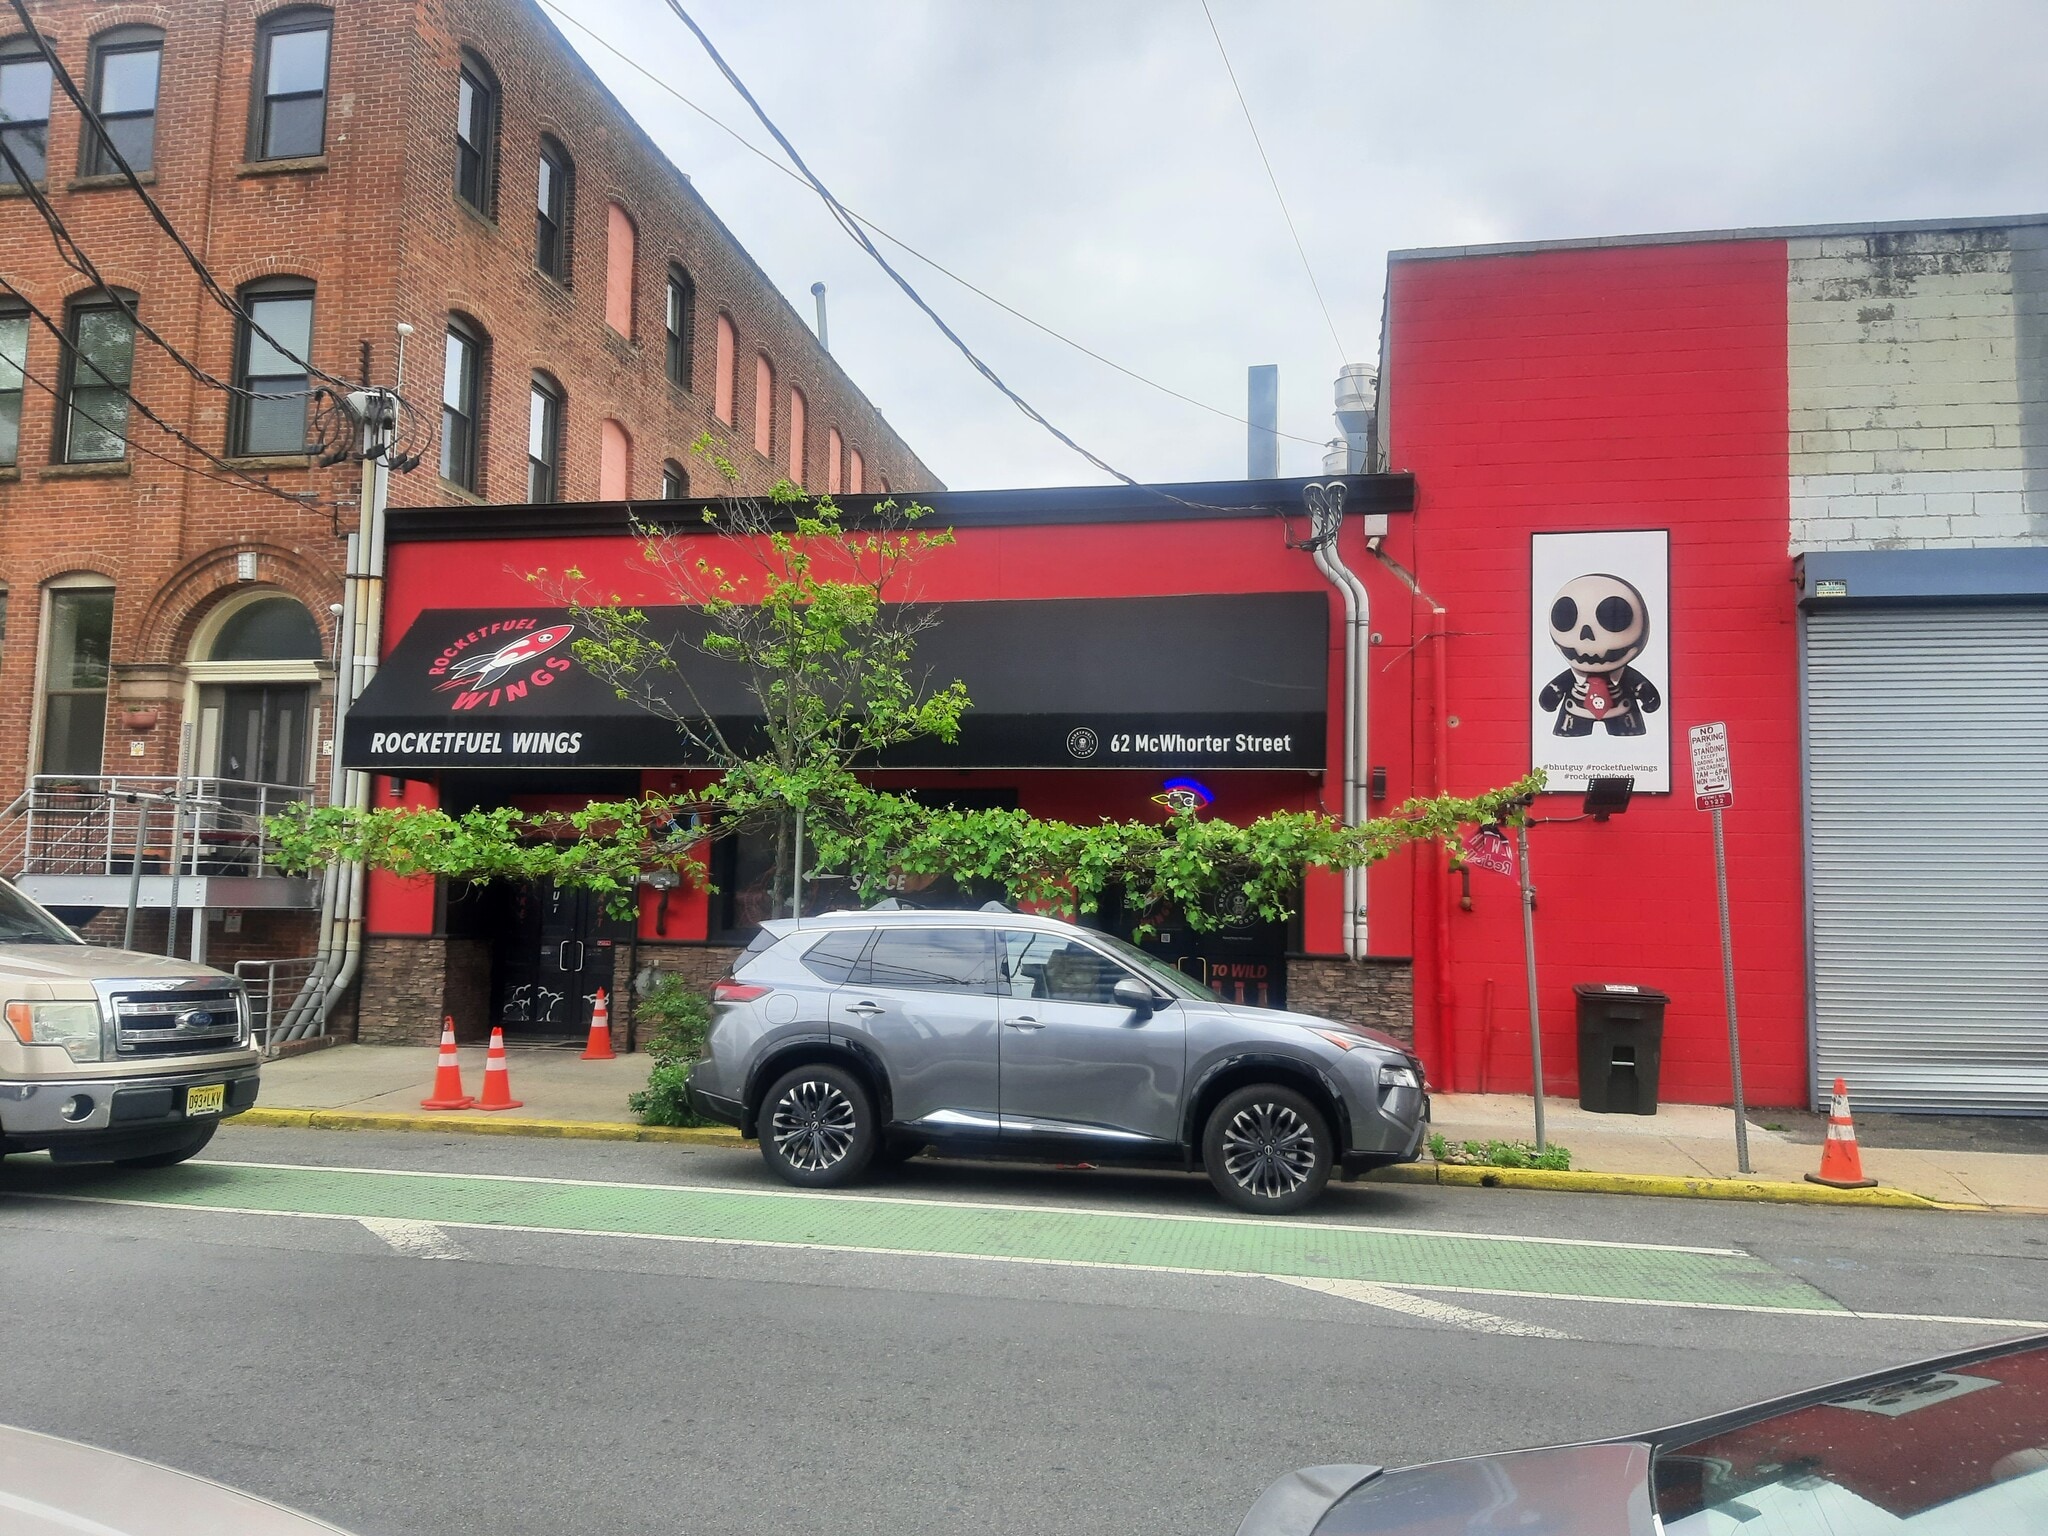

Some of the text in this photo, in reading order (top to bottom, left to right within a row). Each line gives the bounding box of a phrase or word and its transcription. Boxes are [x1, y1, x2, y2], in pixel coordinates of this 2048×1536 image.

[429, 618, 538, 676] ROCKETFUEL
[451, 656, 571, 711] WINGS
[1700, 727, 1714, 735] NO
[370, 732, 583, 754] ROCKETFUEL WINGS
[1110, 733, 1291, 752] 62 McWhorter Street
[1692, 733, 1724, 744] PARKING
[1693, 744, 1725, 756] STANDING
[1543, 763, 1658, 772] #bhutguy #rocketfuelwings
[1697, 763, 1725, 771] UNLOADING
[1696, 771, 1708, 779] 7AM
[1715, 768, 1728, 776] 6PM
[1717, 774, 1728, 782] SAT
[1212, 963, 1268, 978] TO WILD
